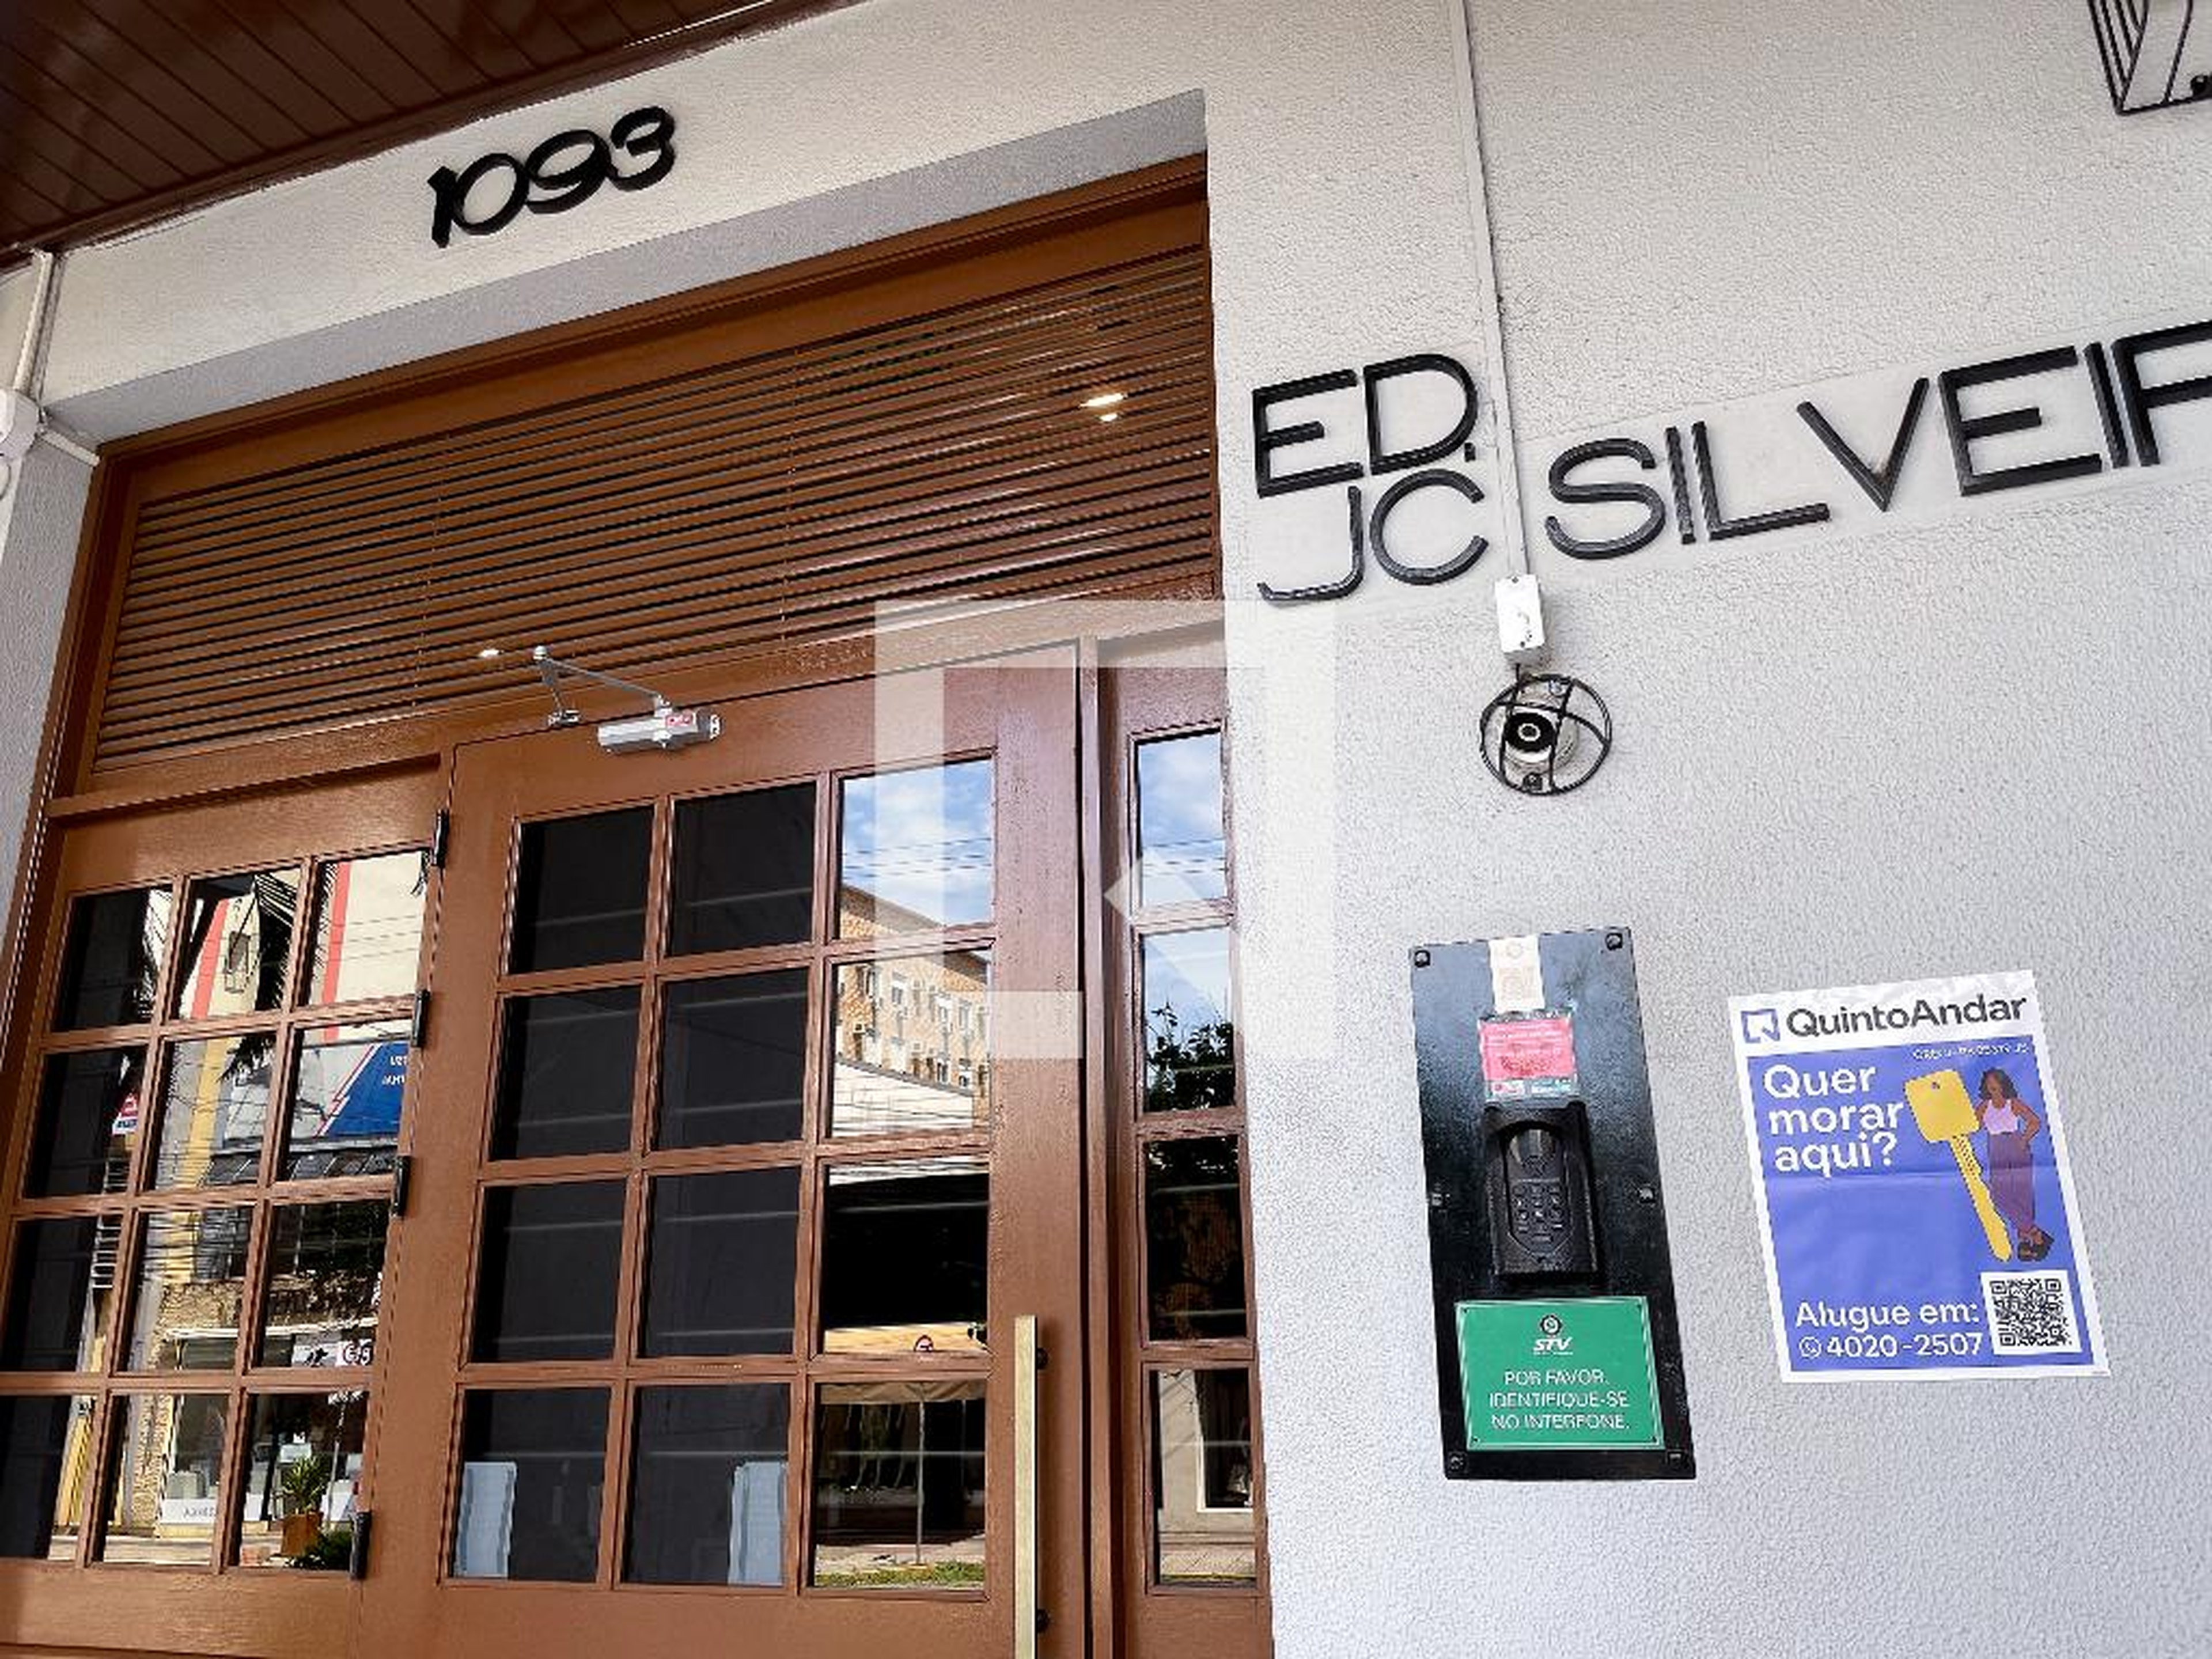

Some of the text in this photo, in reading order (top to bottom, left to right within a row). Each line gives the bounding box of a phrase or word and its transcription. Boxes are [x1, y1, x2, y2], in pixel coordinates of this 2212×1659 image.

[427, 106, 676, 248] 1093
[1252, 353, 1478, 499] ED.
[1256, 468, 1489, 603] JC
[1786, 993, 2027, 1037] QuintoAndar
[1763, 1063, 1877, 1099] Quer
[1768, 1100, 1904, 1136] morar
[1775, 1131, 1897, 1179] aqui?
[1796, 1301, 1980, 1334] Alugue em:
[1533, 1336, 1573, 1352] STV
[1826, 1331, 1984, 1358] 4020-2507
[1505, 1370, 1541, 1385] POR
[1489, 1391, 1630, 1408] IDENTIFIQUE-SE
[1491, 1414, 1630, 1430] NO INTERFONE.
